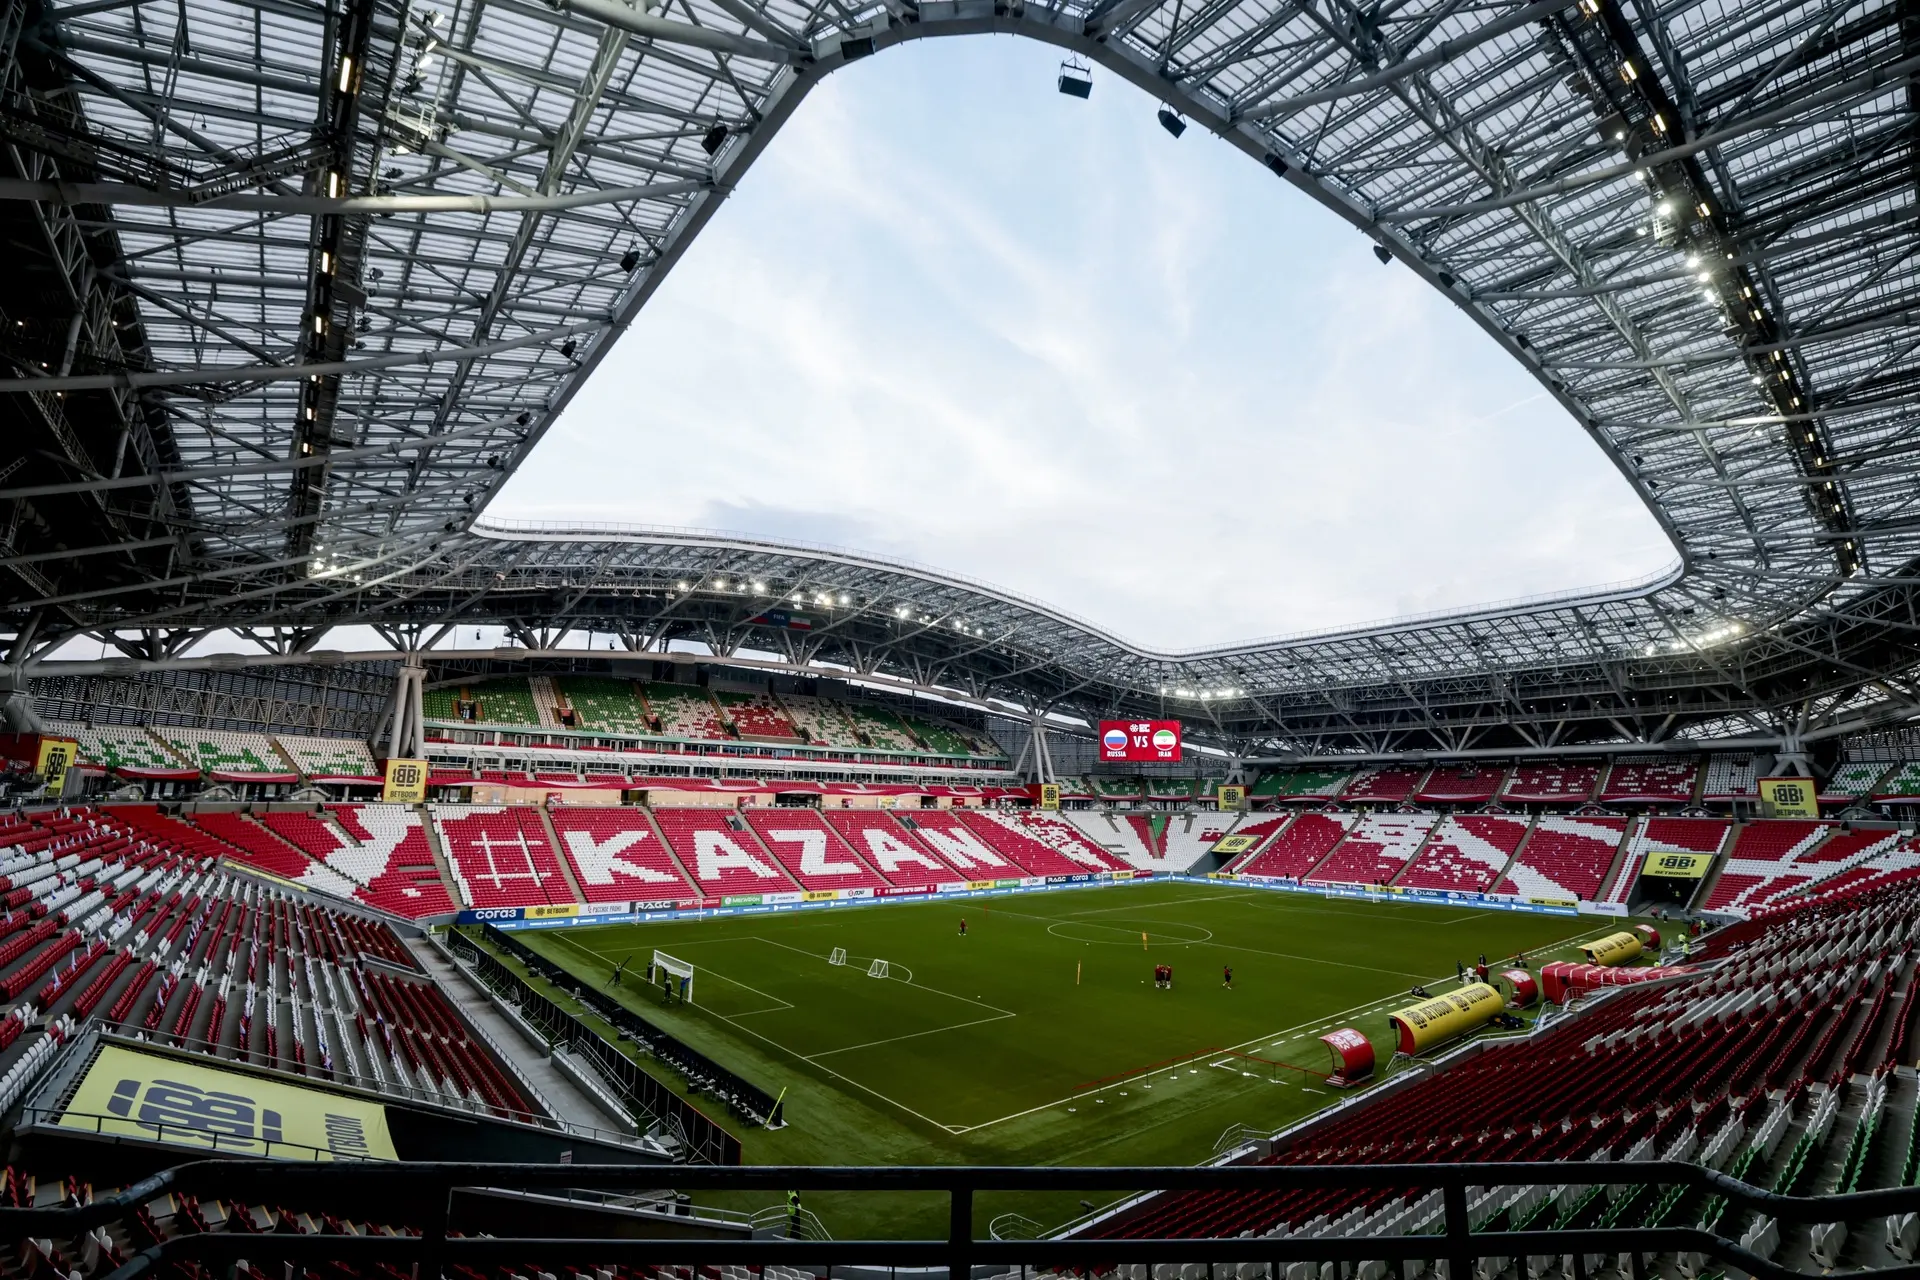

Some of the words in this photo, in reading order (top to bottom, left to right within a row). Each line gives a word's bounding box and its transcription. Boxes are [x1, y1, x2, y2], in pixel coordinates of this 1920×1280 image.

[1133, 735, 1149, 748] VS
[390, 790, 418, 798] BETBOOM
[1422, 890, 1438, 898] LADA
[324, 1112, 371, 1162] TBOOM
